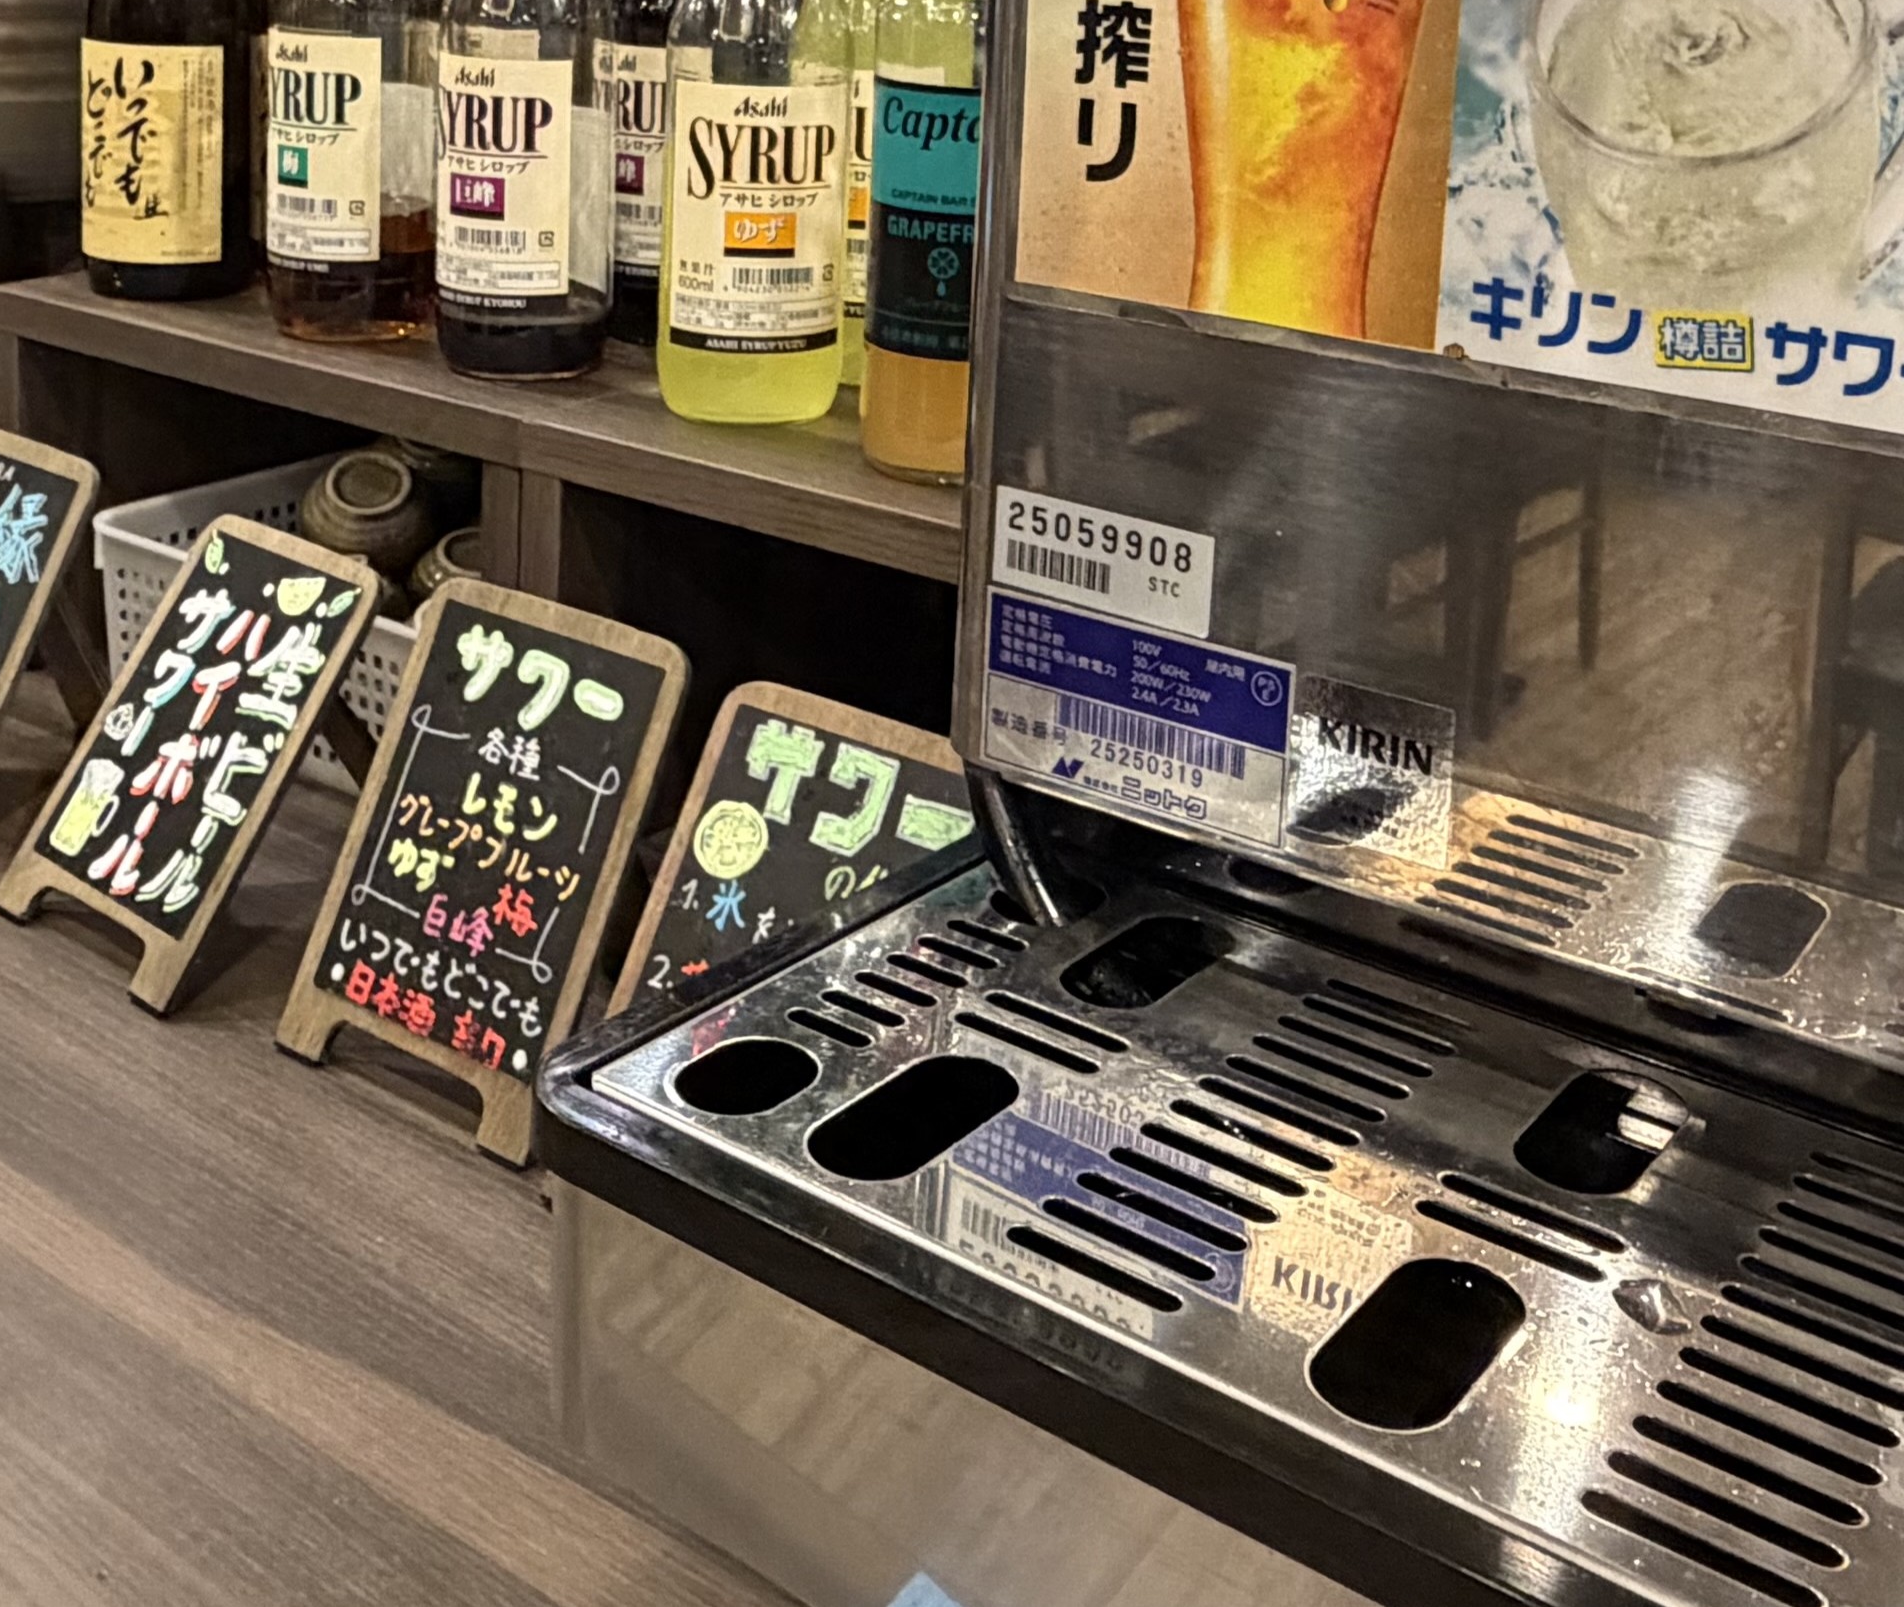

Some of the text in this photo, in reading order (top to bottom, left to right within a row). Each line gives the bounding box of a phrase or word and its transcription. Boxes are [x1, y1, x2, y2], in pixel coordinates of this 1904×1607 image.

[271, 65, 363, 126] YRUP
[454, 66, 496, 89] Asahi
[733, 95, 789, 119] Asahi
[439, 85, 553, 158] YRUP
[687, 115, 836, 200] SYRUP
[719, 191, 820, 209] アサヒ シロップ
[732, 219, 786, 245] ゆず
[1469, 276, 1644, 355] キリン
[1658, 315, 1748, 363] 樽詰
[1007, 500, 1194, 574] 25059908
[1148, 575, 1181, 599] STC
[120, 588, 237, 757] サワー
[456, 622, 624, 732] サワー
[1131, 639, 1163, 658] 100V
[87, 609, 272, 896] ハイボール
[477, 727, 542, 781] 各種
[1089, 738, 1204, 789] 25250319
[1315, 716, 1434, 777] KIRIN
[461, 771, 558, 841] レモン
[745, 718, 978, 858] サワー
[387, 836, 456, 893] ゆず
[399, 793, 580, 902] グレープフルーツ
[422, 893, 495, 958] 巨峰
[339, 917, 544, 1038] いつでもどこでも
[345, 957, 437, 1038] 日本酒
